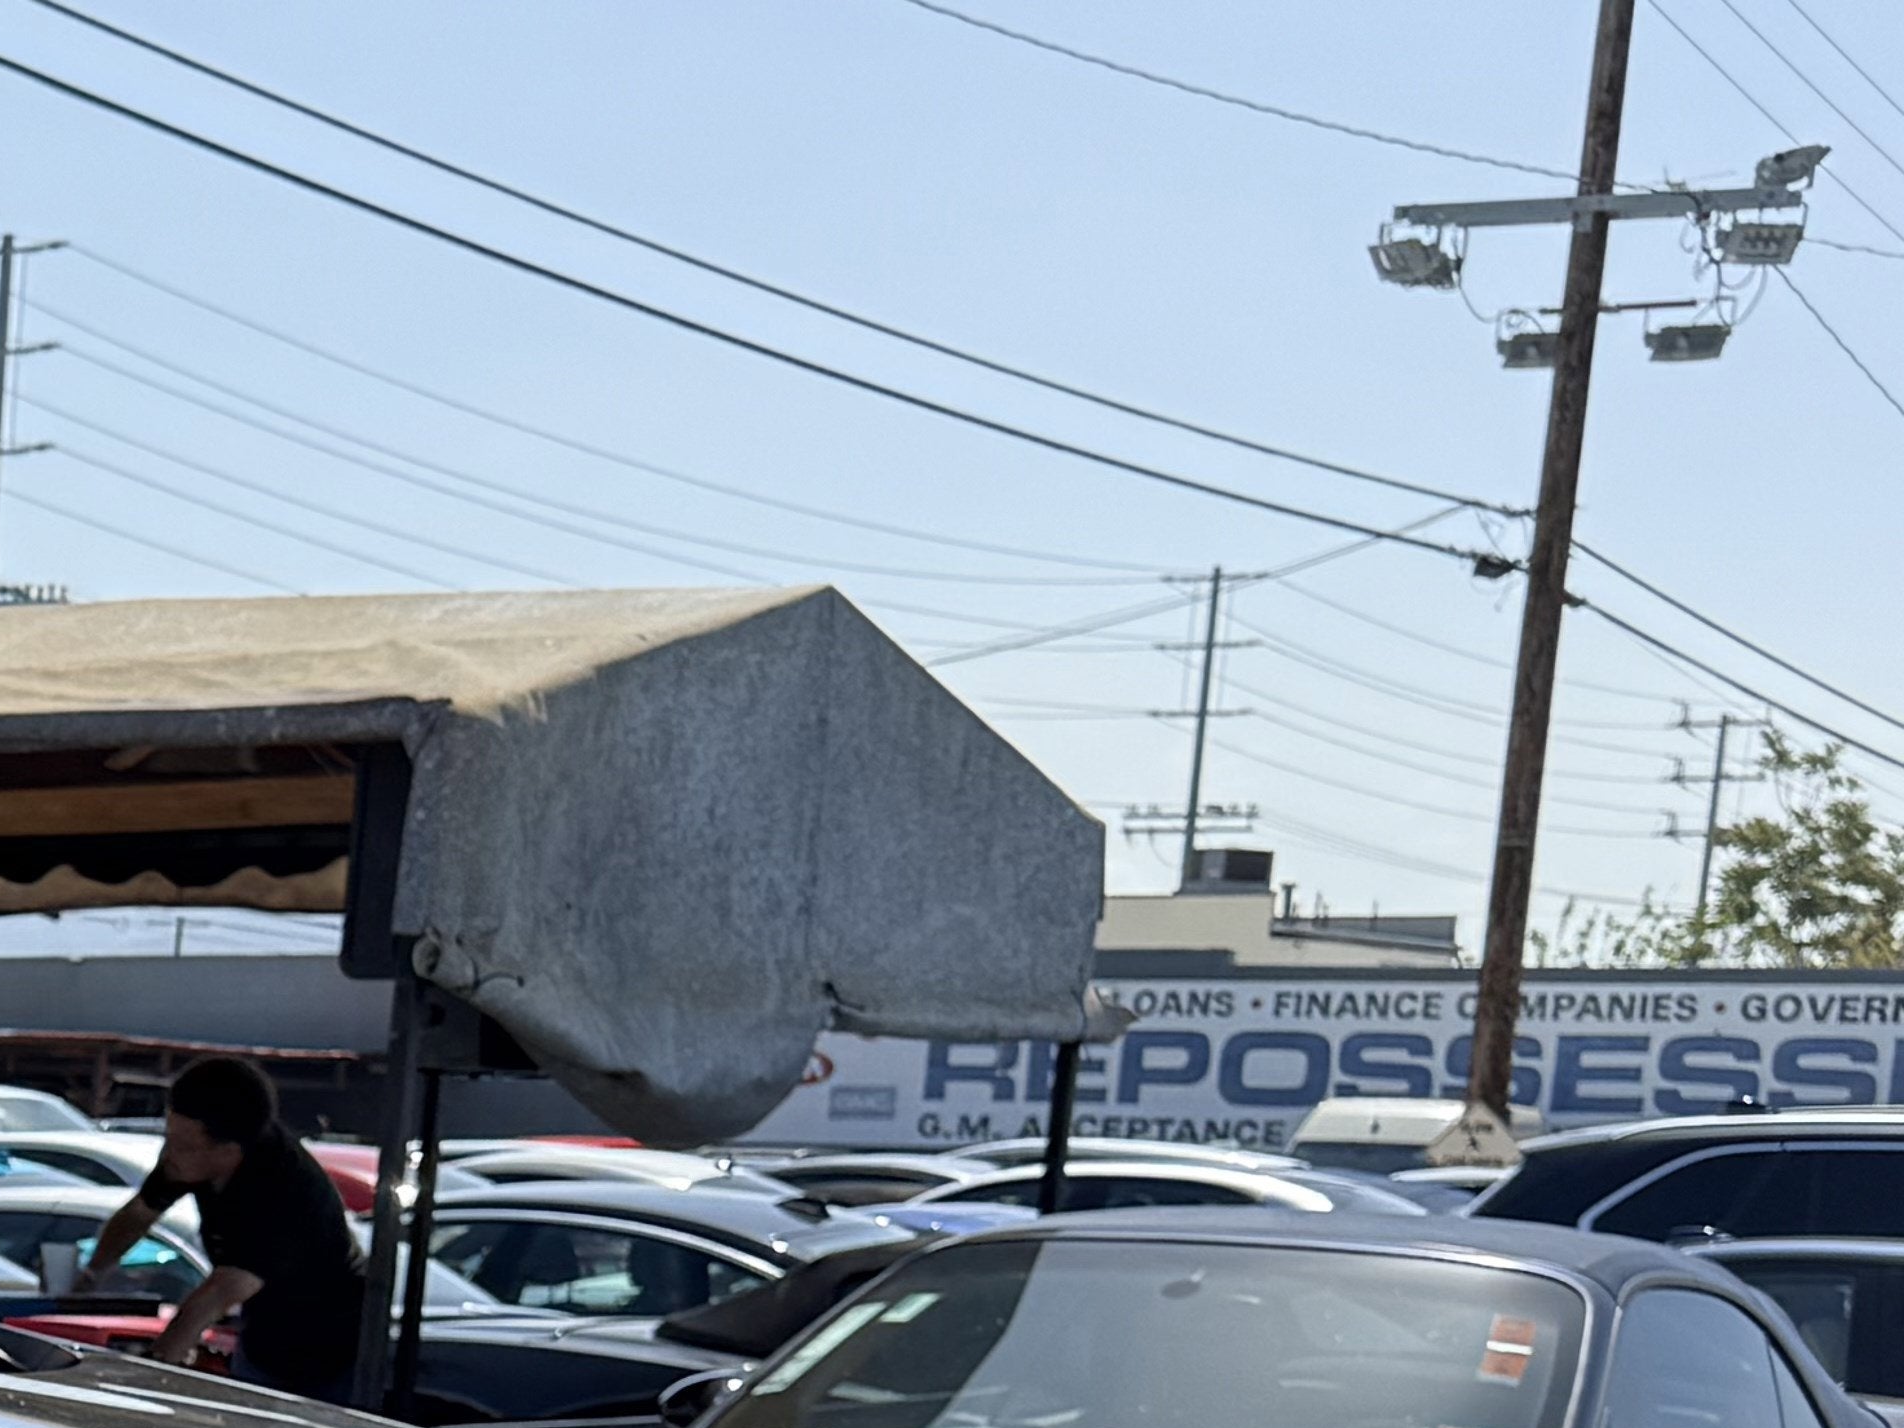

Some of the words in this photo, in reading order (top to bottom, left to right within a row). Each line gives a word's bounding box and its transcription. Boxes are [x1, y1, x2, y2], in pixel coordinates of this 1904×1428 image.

[1111, 988, 1234, 1018] OANS
[1273, 991, 1443, 1020] FINANCE
[1457, 991, 1699, 1022] CMPANIES
[1017, 1114, 1287, 1148] ACEPTANCE
